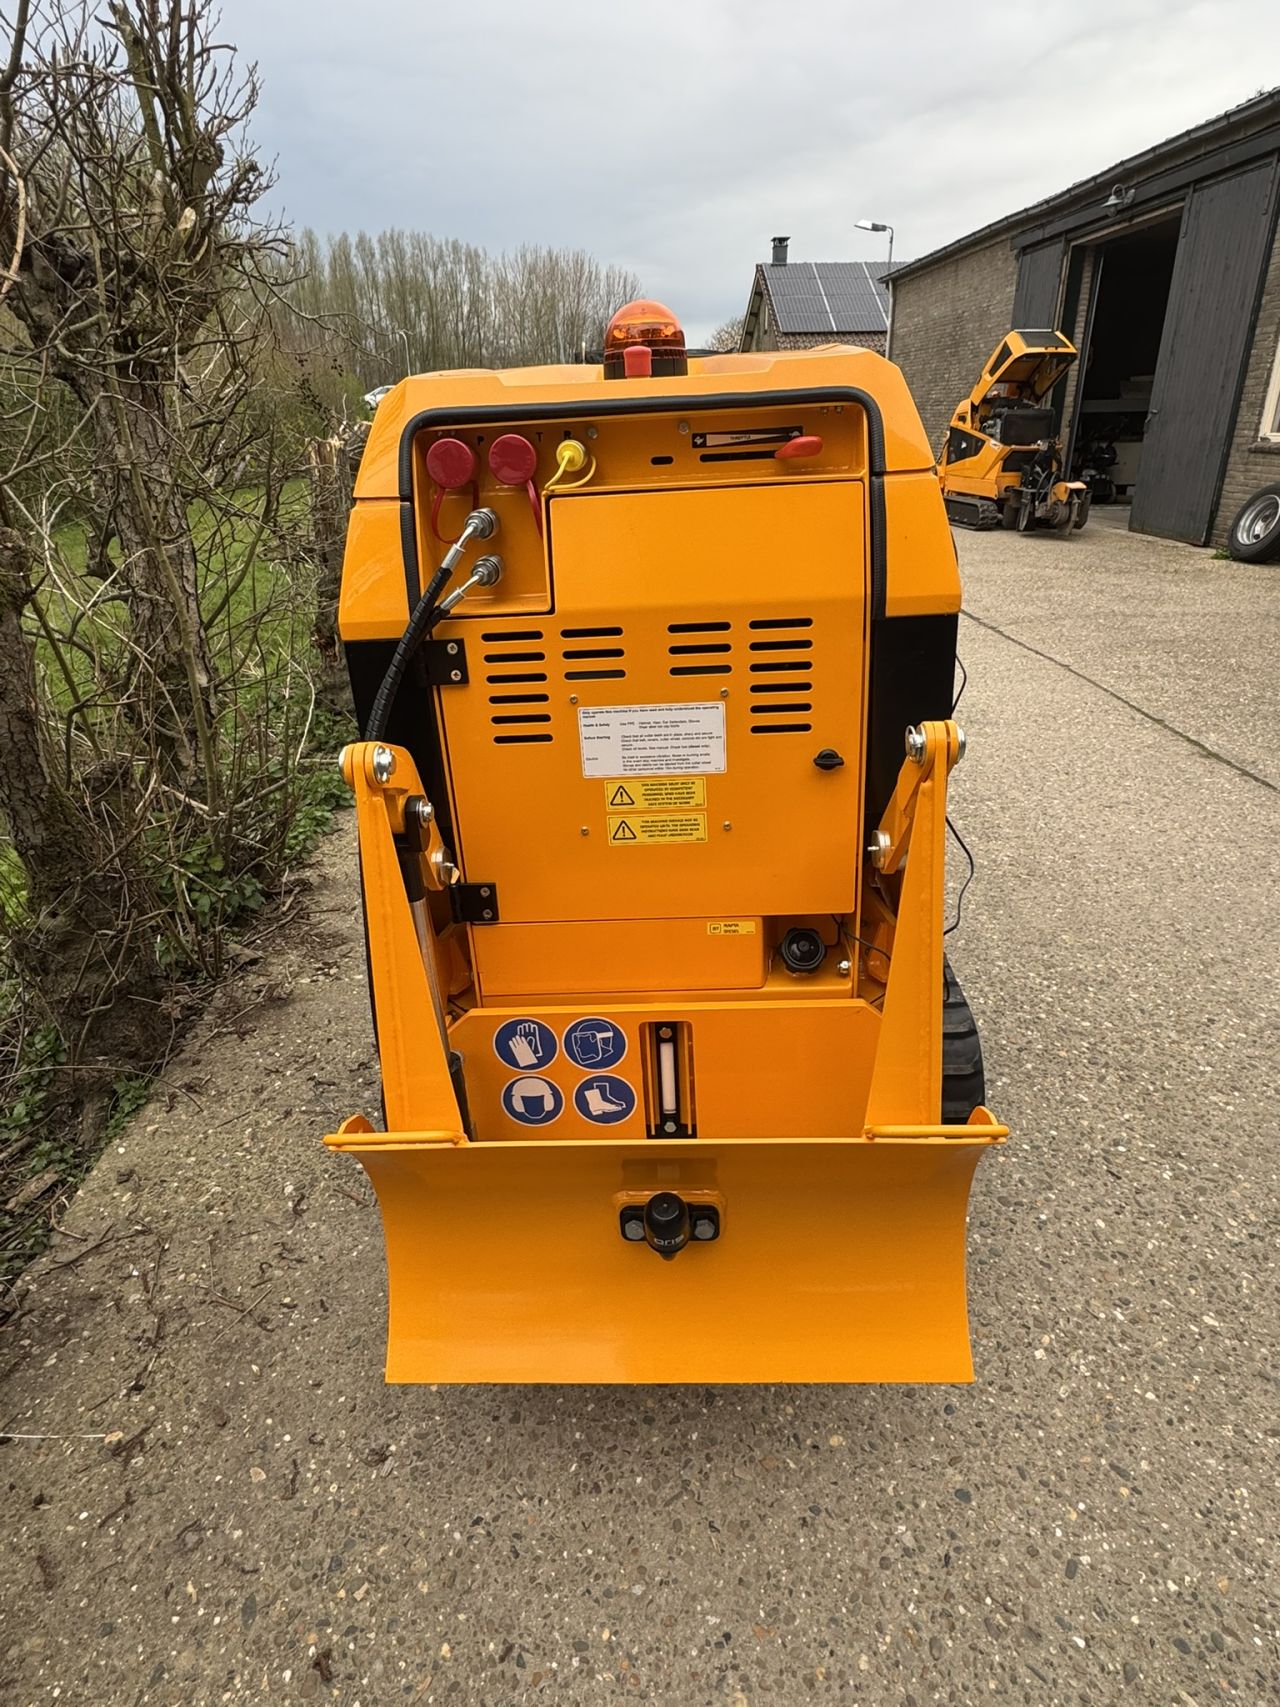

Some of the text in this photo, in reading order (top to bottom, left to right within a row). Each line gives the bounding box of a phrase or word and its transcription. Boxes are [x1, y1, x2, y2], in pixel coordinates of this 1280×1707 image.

[536, 432, 544, 442] T
[563, 430, 572, 439] R
[477, 435, 484, 446] P
